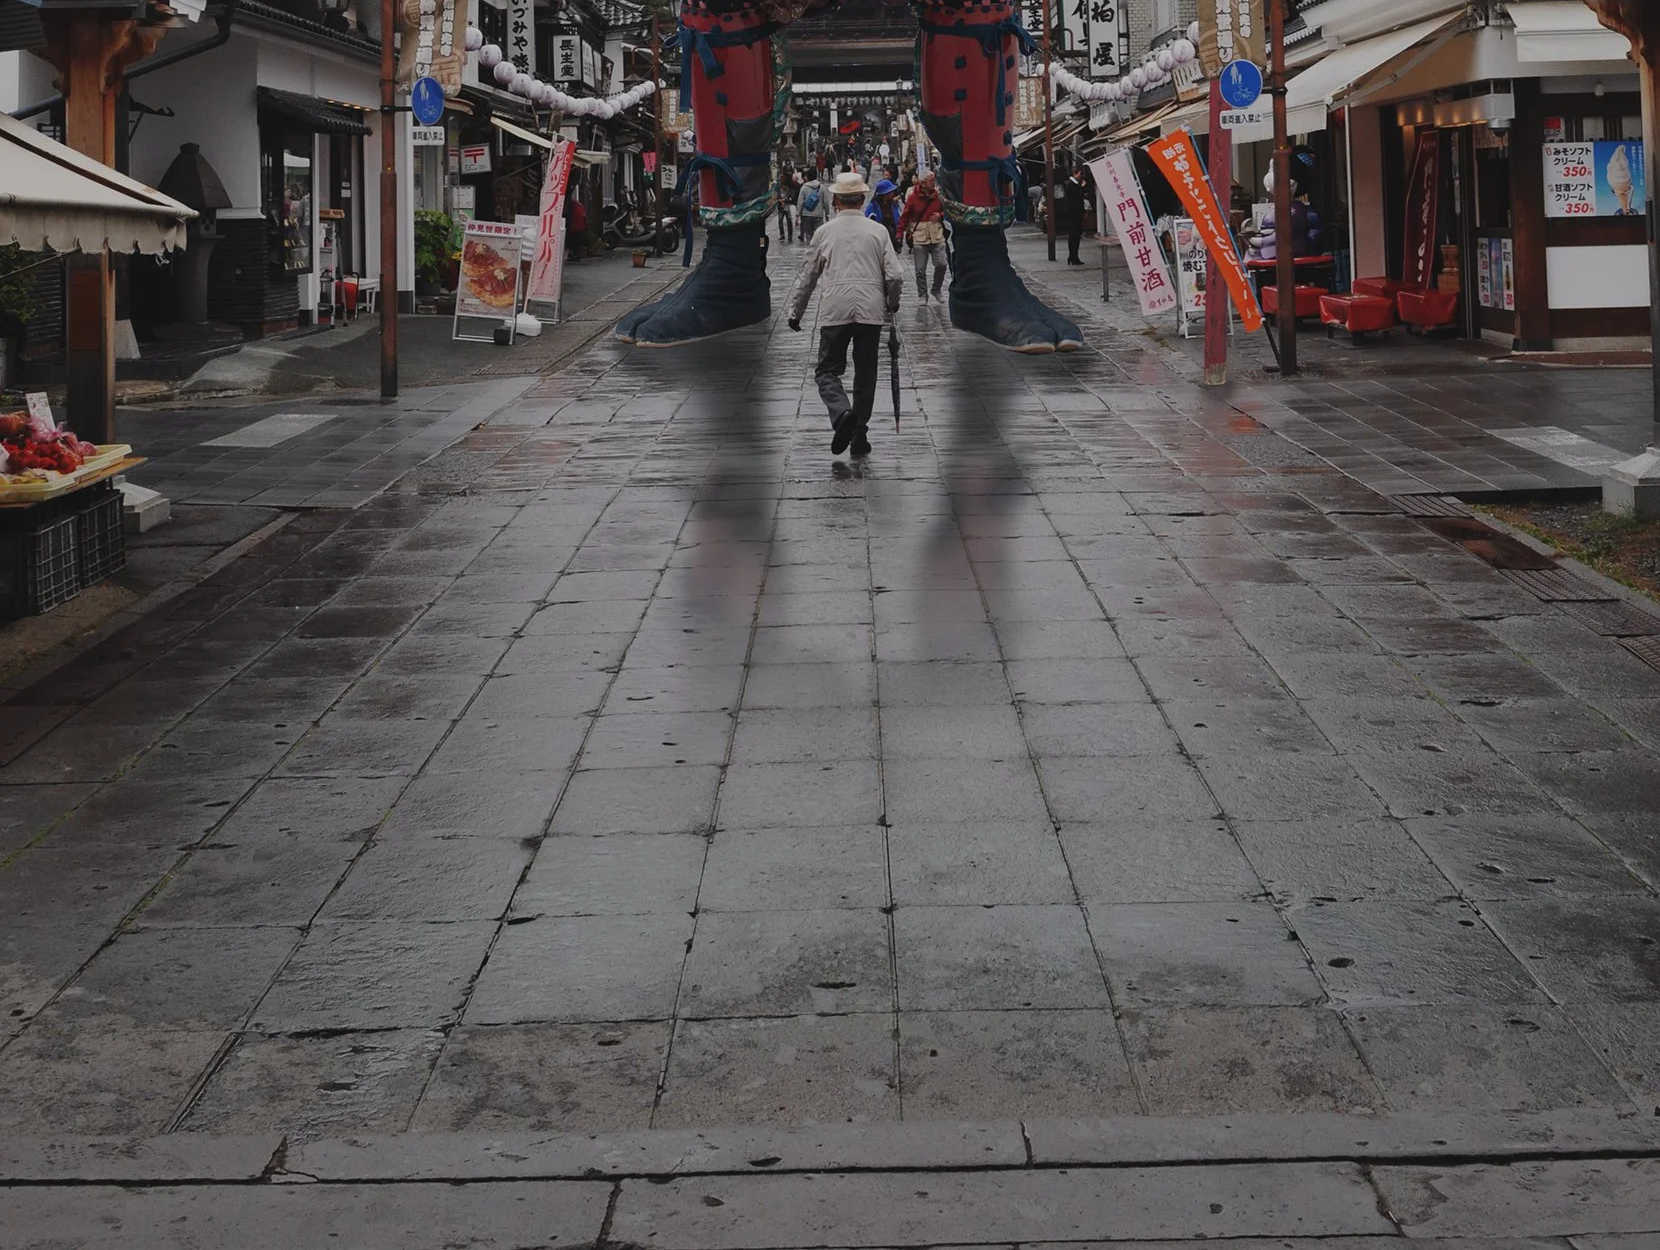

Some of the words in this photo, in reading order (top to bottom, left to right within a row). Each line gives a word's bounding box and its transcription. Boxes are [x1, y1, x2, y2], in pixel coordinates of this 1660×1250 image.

[1090, 0, 1115, 67] 柏屋
[559, 39, 574, 78] 長生堂
[1553, 147, 1591, 156] みそソフト
[1553, 157, 1584, 166] クリーム
[1554, 183, 1593, 192] 甘酒ソフト
[1555, 193, 1586, 202] クリーム
[1117, 198, 1165, 293] 門前甘酒
[1189, 249, 1207, 259] のり
